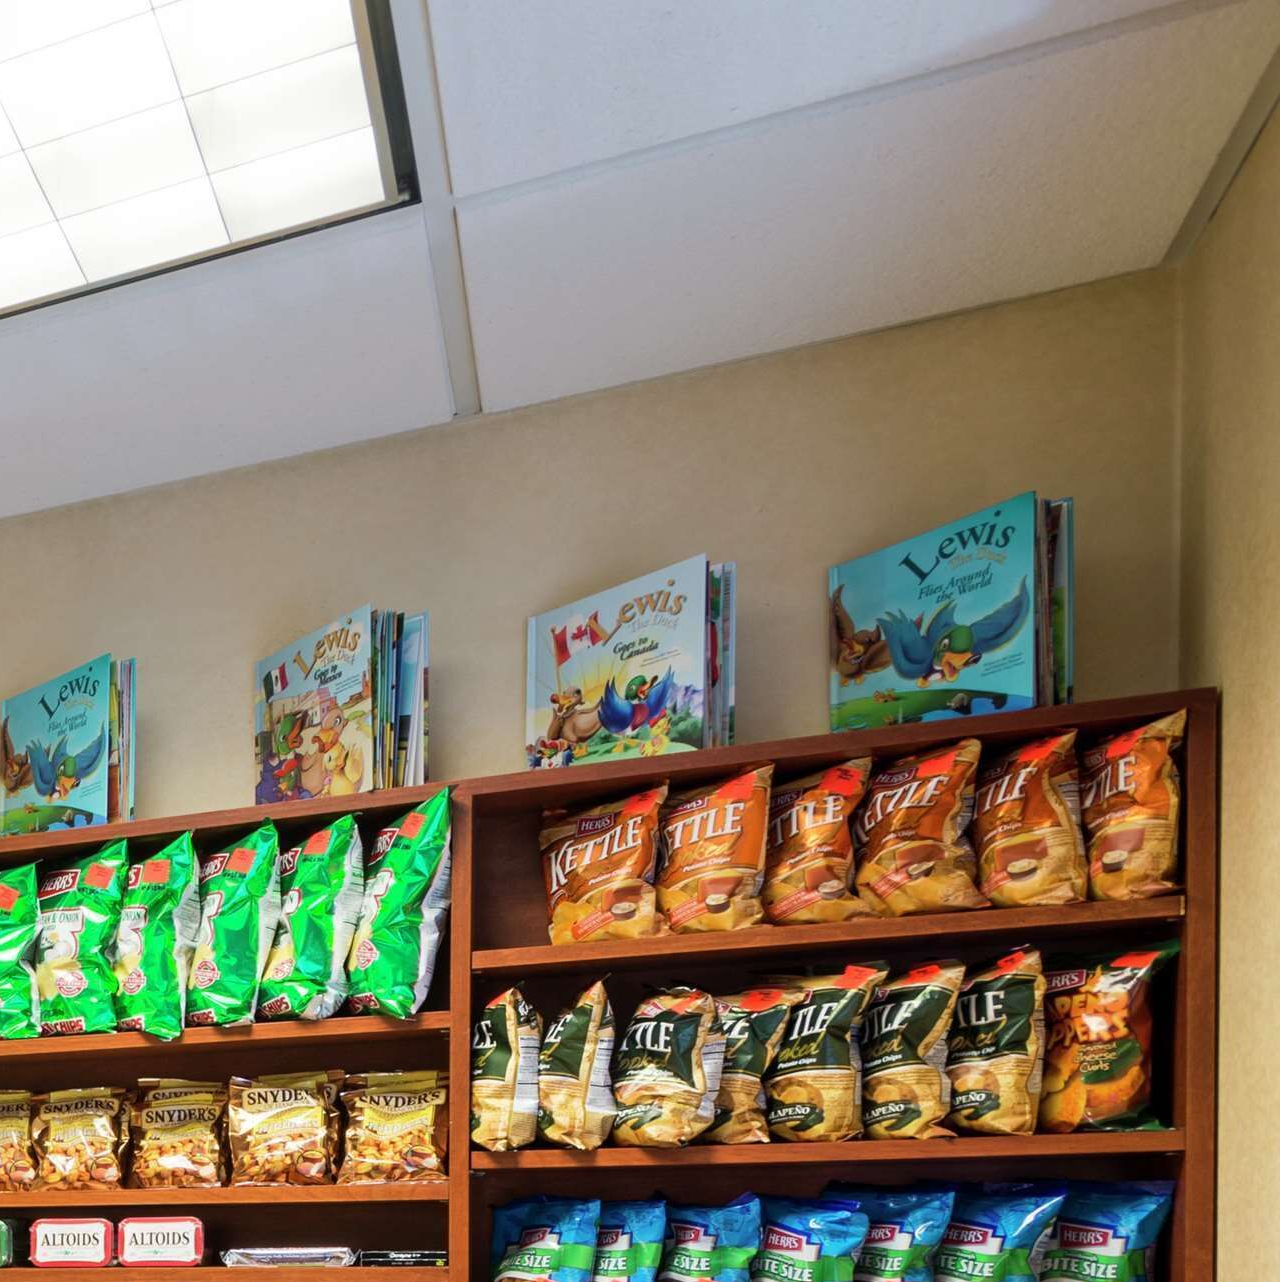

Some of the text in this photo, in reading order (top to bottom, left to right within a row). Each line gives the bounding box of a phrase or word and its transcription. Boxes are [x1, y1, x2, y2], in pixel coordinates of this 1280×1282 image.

[897, 510, 1016, 586] Lewis
[945, 563, 992, 591] Around
[594, 580, 688, 647] Lewis
[292, 618, 361, 680] Lewis
[37, 666, 101, 719] Lewis
[549, 818, 642, 894] KETTLE
[57, 1020, 84, 1031] CHIPS
[43, 1099, 114, 1114] SNYDER'S
[359, 1090, 440, 1108] SNYDER'S
[145, 1108, 217, 1123] SNYDER'S
[41, 1232, 100, 1248] ALTOIDS
[129, 1231, 190, 1247] ALTOIDS
[768, 1234, 798, 1249] HERR'S
[947, 1228, 984, 1242] HERR'S
[1064, 1230, 1104, 1244] HERR'S
[599, 1257, 627, 1270] SIZE
[682, 1256, 710, 1270] SIZE
[1042, 1259, 1118, 1279] BITE SIZE
[783, 1263, 813, 1282] SIZE
